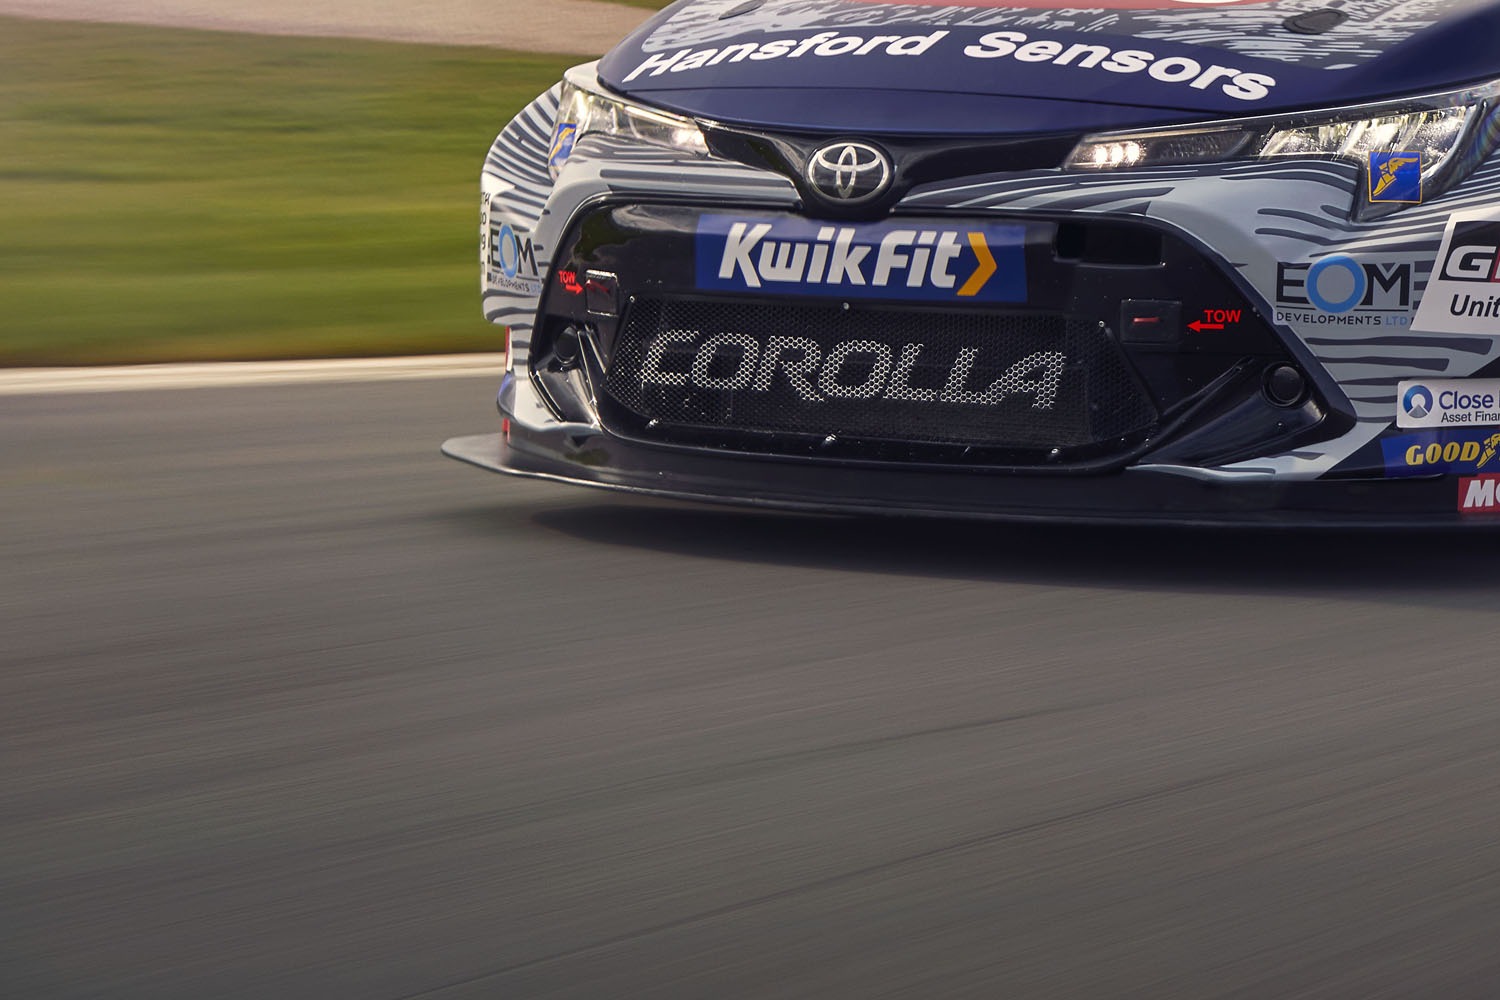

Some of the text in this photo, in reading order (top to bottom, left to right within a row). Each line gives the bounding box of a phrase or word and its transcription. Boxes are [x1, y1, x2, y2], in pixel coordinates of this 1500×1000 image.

[622, 30, 1276, 101] Hansford Sensors
[490, 224, 539, 279] EOM
[558, 269, 576, 285] TOW
[1276, 255, 1410, 313] EOM
[1204, 310, 1241, 323] TOW
[1276, 311, 1408, 327] DEVELOPMENTS LTD
[641, 328, 1067, 410] COROLLA
[1438, 390, 1494, 411] Close
[1440, 412, 1472, 423] Asset
